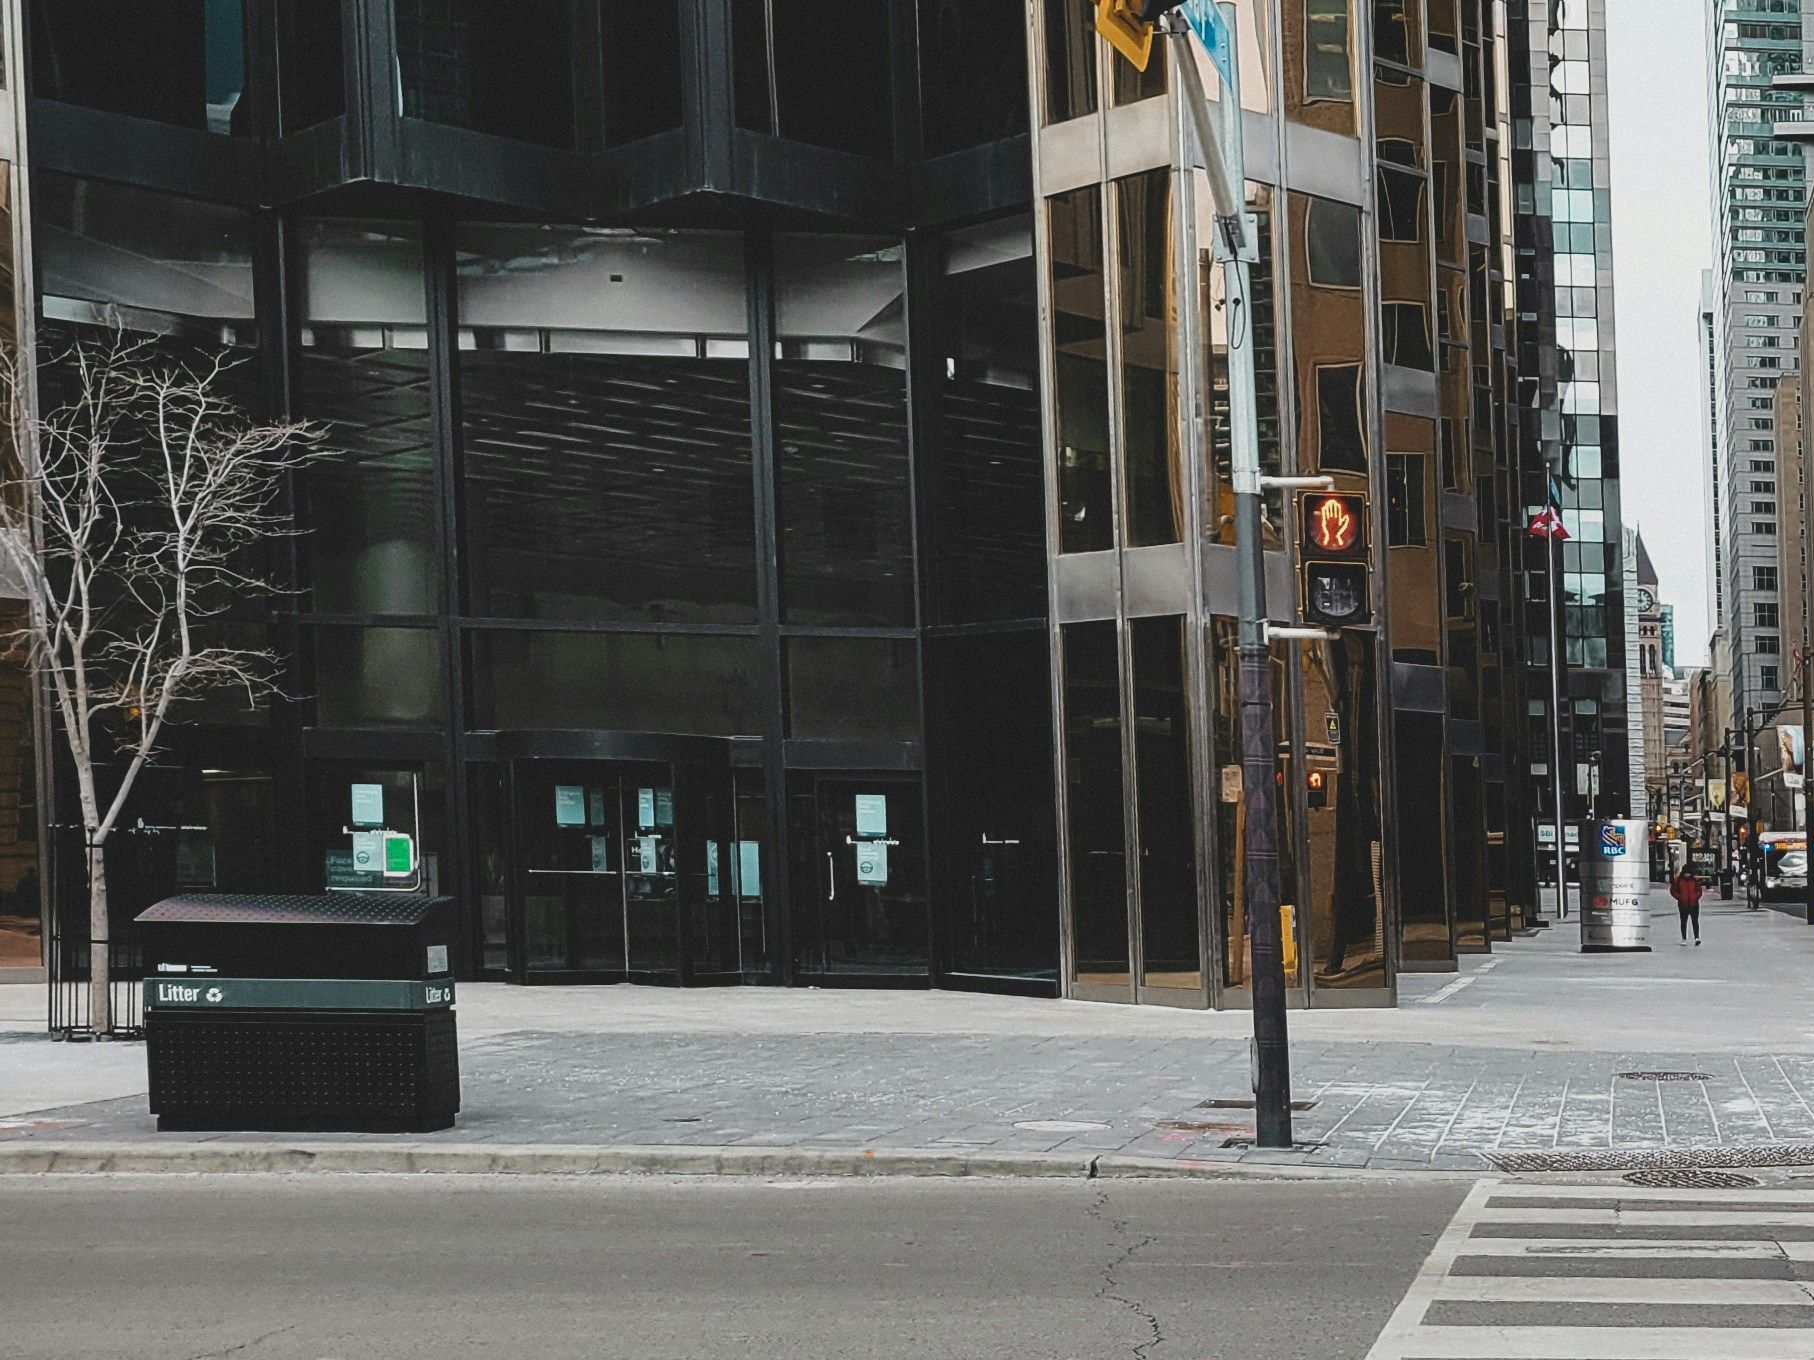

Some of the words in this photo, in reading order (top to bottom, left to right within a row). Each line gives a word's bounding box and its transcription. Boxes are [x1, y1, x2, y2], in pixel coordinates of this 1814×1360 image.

[1603, 846, 1625, 855] RBC
[1611, 898, 1639, 906] MUFG
[158, 984, 201, 1001] Litter
